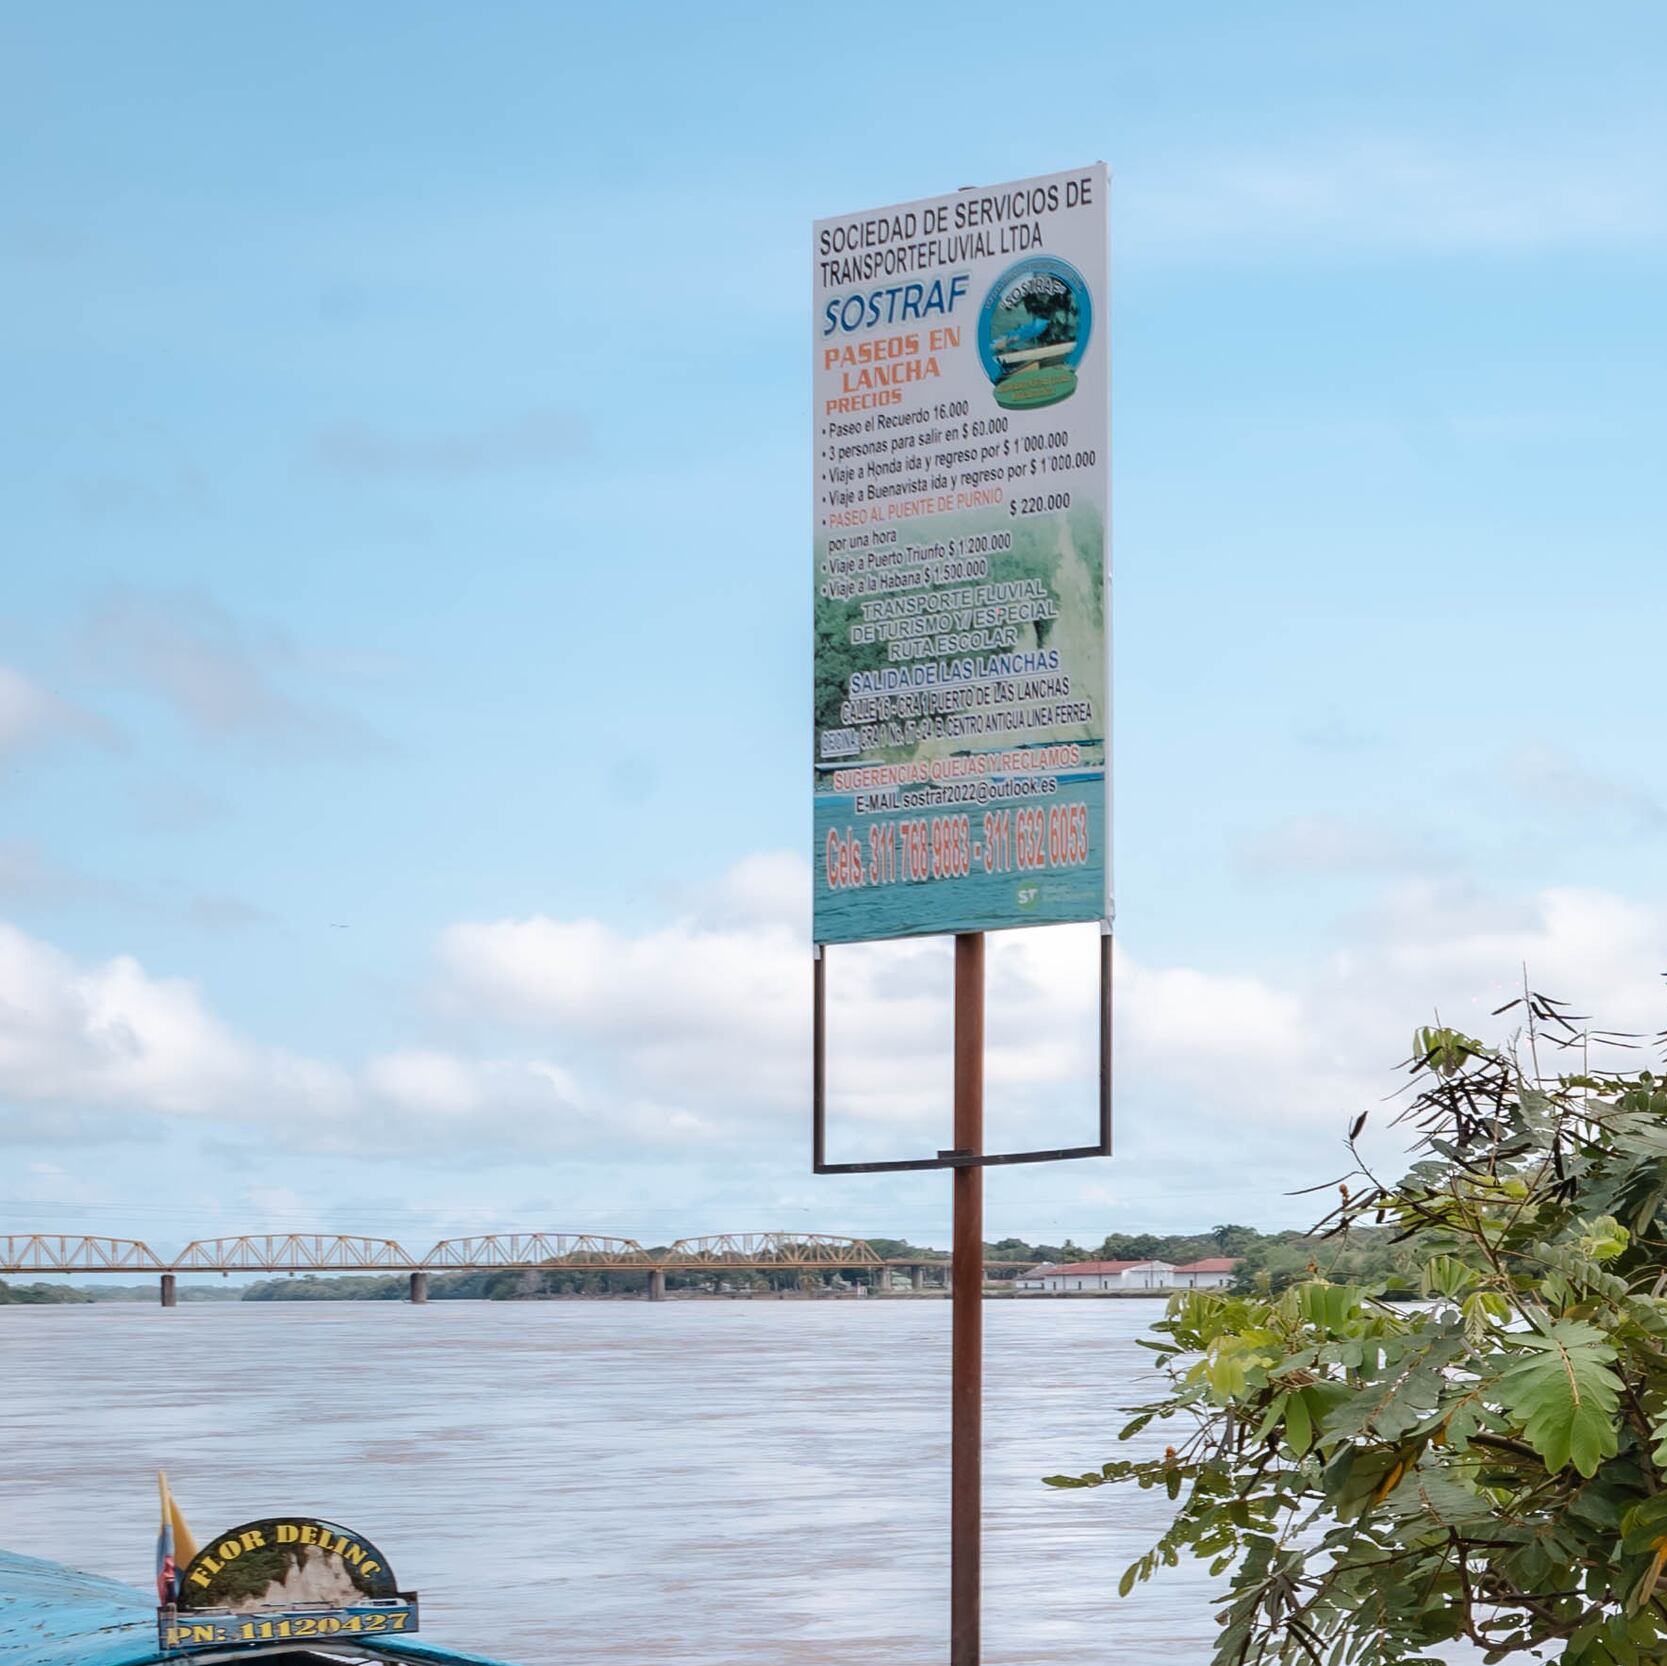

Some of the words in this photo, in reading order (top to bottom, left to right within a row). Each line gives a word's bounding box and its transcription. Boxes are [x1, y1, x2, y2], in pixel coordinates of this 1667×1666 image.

[820, 213, 916, 256] SOCIEDAD
[924, 206, 948, 235] DE
[954, 185, 1059, 229] SERVICIOS
[1066, 177, 1092, 208] DE
[821, 230, 995, 288] TRANSPORTEFLUVIAL
[1000, 221, 1043, 254] LTDA
[824, 274, 970, 336] SOSTRAF
[824, 333, 919, 371] PASEOS
[928, 325, 961, 352] EN
[842, 356, 941, 393] LANCHA
[826, 388, 903, 415] PRECIOS
[829, 421, 862, 438] Paseo
[864, 416, 875, 432] el
[877, 408, 930, 430] Recuerdo
[934, 399, 969, 420] 16.000
[829, 445, 836, 461] 3
[838, 440, 888, 463] personas
[891, 434, 915, 454] para
[918, 428, 942, 446] salir
[945, 428, 959, 441] en
[962, 422, 969, 440] $
[972, 416, 1009, 437] 60.000
[829, 466, 855, 485] Viaje
[857, 467, 864, 479] a
[867, 458, 902, 477] Honda
[905, 455, 922, 471] ida
[925, 456, 932, 473] y
[935, 449, 978, 468] regreso
[981, 445, 1001, 463] por
[1003, 439, 1010, 456] $
[829, 489, 855, 508] Viaje
[857, 490, 864, 502] a
[867, 478, 928, 501] Buenavista
[931, 473, 948, 490] ida
[951, 475, 958, 491] y
[960, 467, 1004, 488] regreso
[1008, 464, 1027, 482] por
[1030, 458, 1037, 475] $
[829, 508, 868, 528] PASEO
[870, 507, 884, 522] AL
[888, 498, 934, 520] PUENTE
[937, 495, 953, 513] DE
[957, 487, 1003, 510] PURNIO
[1009, 499, 1017, 516] $
[1020, 492, 1070, 514] 220.000
[828, 538, 847, 555] por
[849, 534, 869, 549] una
[872, 529, 897, 545] hora
[829, 558, 855, 576] Viaje
[857, 558, 864, 570] a
[867, 552, 903, 569] Puerto
[906, 542, 945, 563] Triunfo
[948, 540, 955, 557] $
[960, 532, 1011, 555] 1.200.000
[829, 580, 855, 599] Viaje
[857, 581, 864, 593] a
[867, 574, 877, 592] la
[880, 572, 921, 589] Habana
[924, 565, 931, 583] $
[934, 559, 986, 582] 1.500.000
[863, 588, 972, 620] TRANSPORTE
[975, 580, 1046, 606] FLUVIAL
[853, 625, 875, 643] DE
[878, 614, 949, 639] TURISMO
[975, 602, 1057, 627] ESPECIAL
[889, 640, 935, 660] RUTA
[938, 629, 1016, 654] ESCOLAR
[851, 669, 910, 694] SALIDA
[915, 665, 936, 686] DE
[941, 661, 972, 683] LAS
[979, 650, 1059, 677] LANCHAS
[841, 699, 877, 724] CALLE
[898, 694, 921, 717] CRA
[931, 688, 974, 714] PUERTO
[976, 686, 990, 706] DE
[994, 683, 1014, 704] LAS
[1018, 677, 1069, 701] LANCHAS
[947, 714, 984, 737] CENTRO
[986, 710, 1024, 732] ANTIGUA
[1027, 706, 1053, 727] LINEA
[1056, 702, 1092, 724] FERREA
[834, 762, 928, 791] SUGERENCIAS
[931, 757, 986, 780] QUEJAS
[1002, 745, 1080, 771] RECLAMOS
[856, 792, 900, 813] E-MAIL
[903, 777, 1056, 808] sostraf2022@outlook.es
[827, 828, 865, 887] Cels.
[870, 825, 895, 884] 311
[901, 821, 928, 880] 768
[933, 817, 970, 877] 9883
[984, 810, 1010, 872] 311
[1017, 809, 1044, 868] 632
[1050, 804, 1087, 864] 6053
[189, 1529, 267, 1588] FLOR
[276, 1524, 382, 1579] DELINC
[166, 1624, 227, 1646] PN:
[240, 1612, 410, 1641] 11120427
